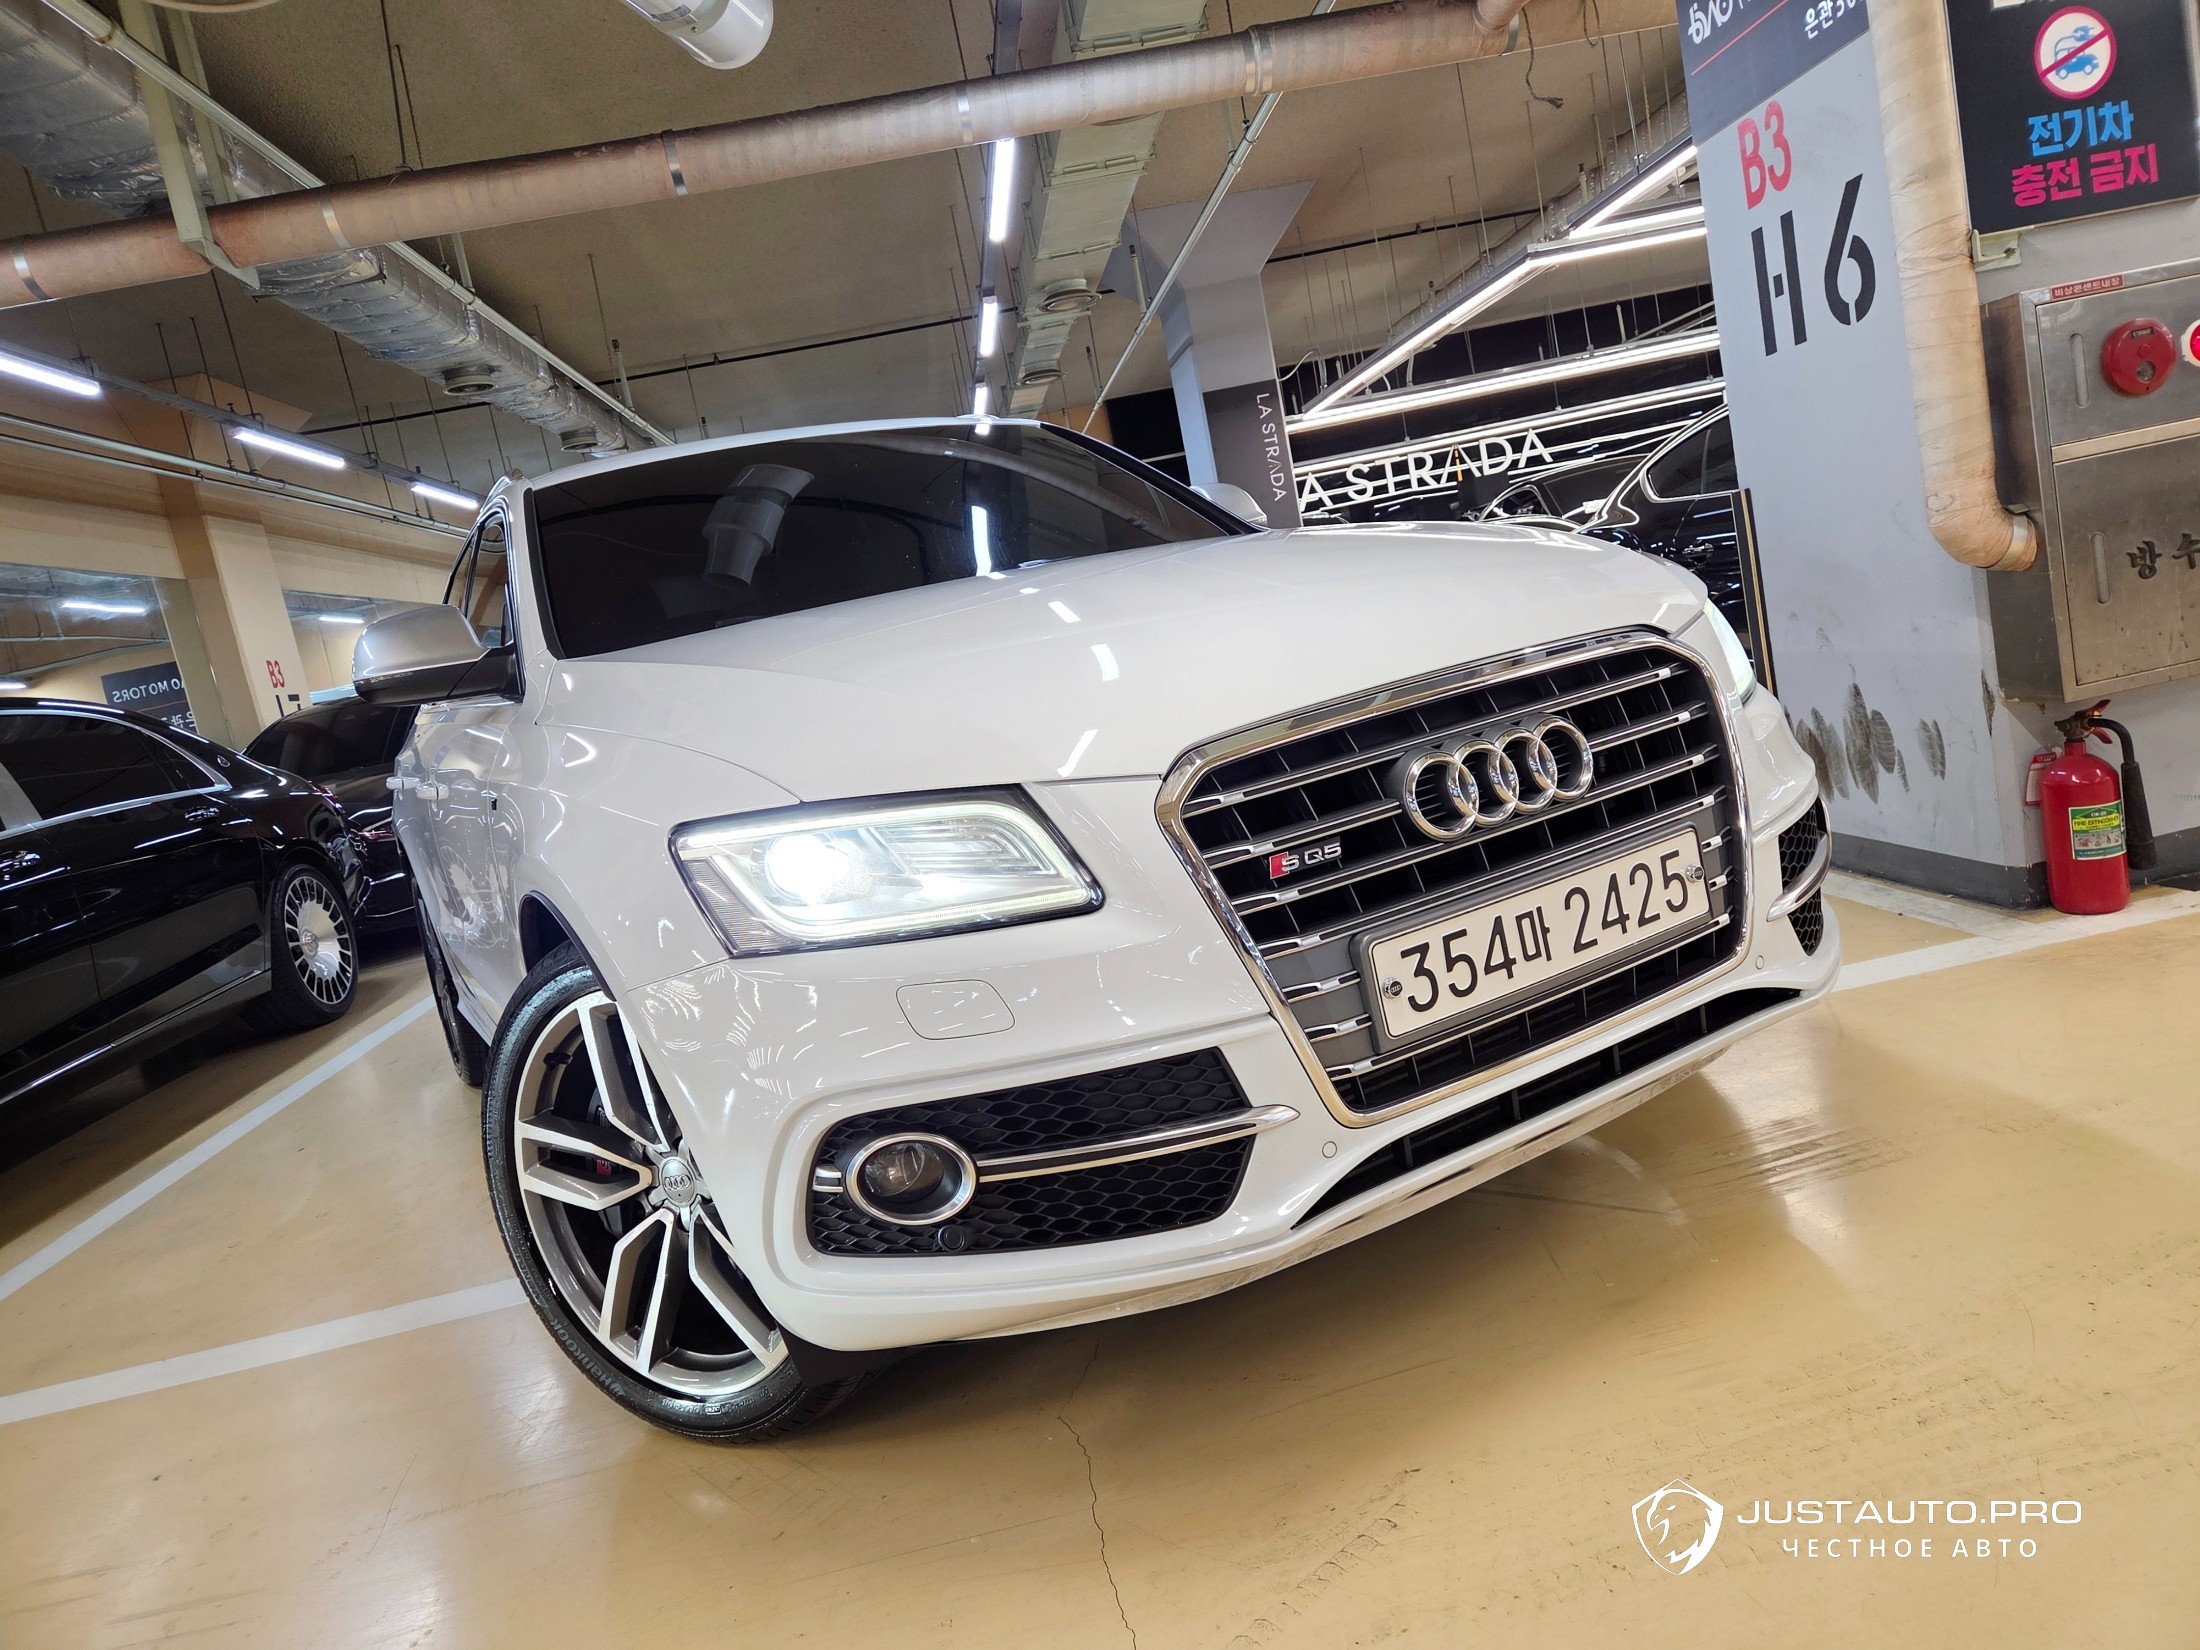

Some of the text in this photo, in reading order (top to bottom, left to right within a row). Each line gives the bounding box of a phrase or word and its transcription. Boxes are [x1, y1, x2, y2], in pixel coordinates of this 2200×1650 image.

[1737, 99, 1792, 210] B3
[2027, 100, 2134, 157] 전기차
[2011, 143, 2159, 207] 충전 금지
[1256, 393, 1287, 501] LA STRADA
[1346, 427, 1553, 501] STRADA
[266, 659, 286, 689] B3
[1399, 848, 1690, 1013] 354마 2425
